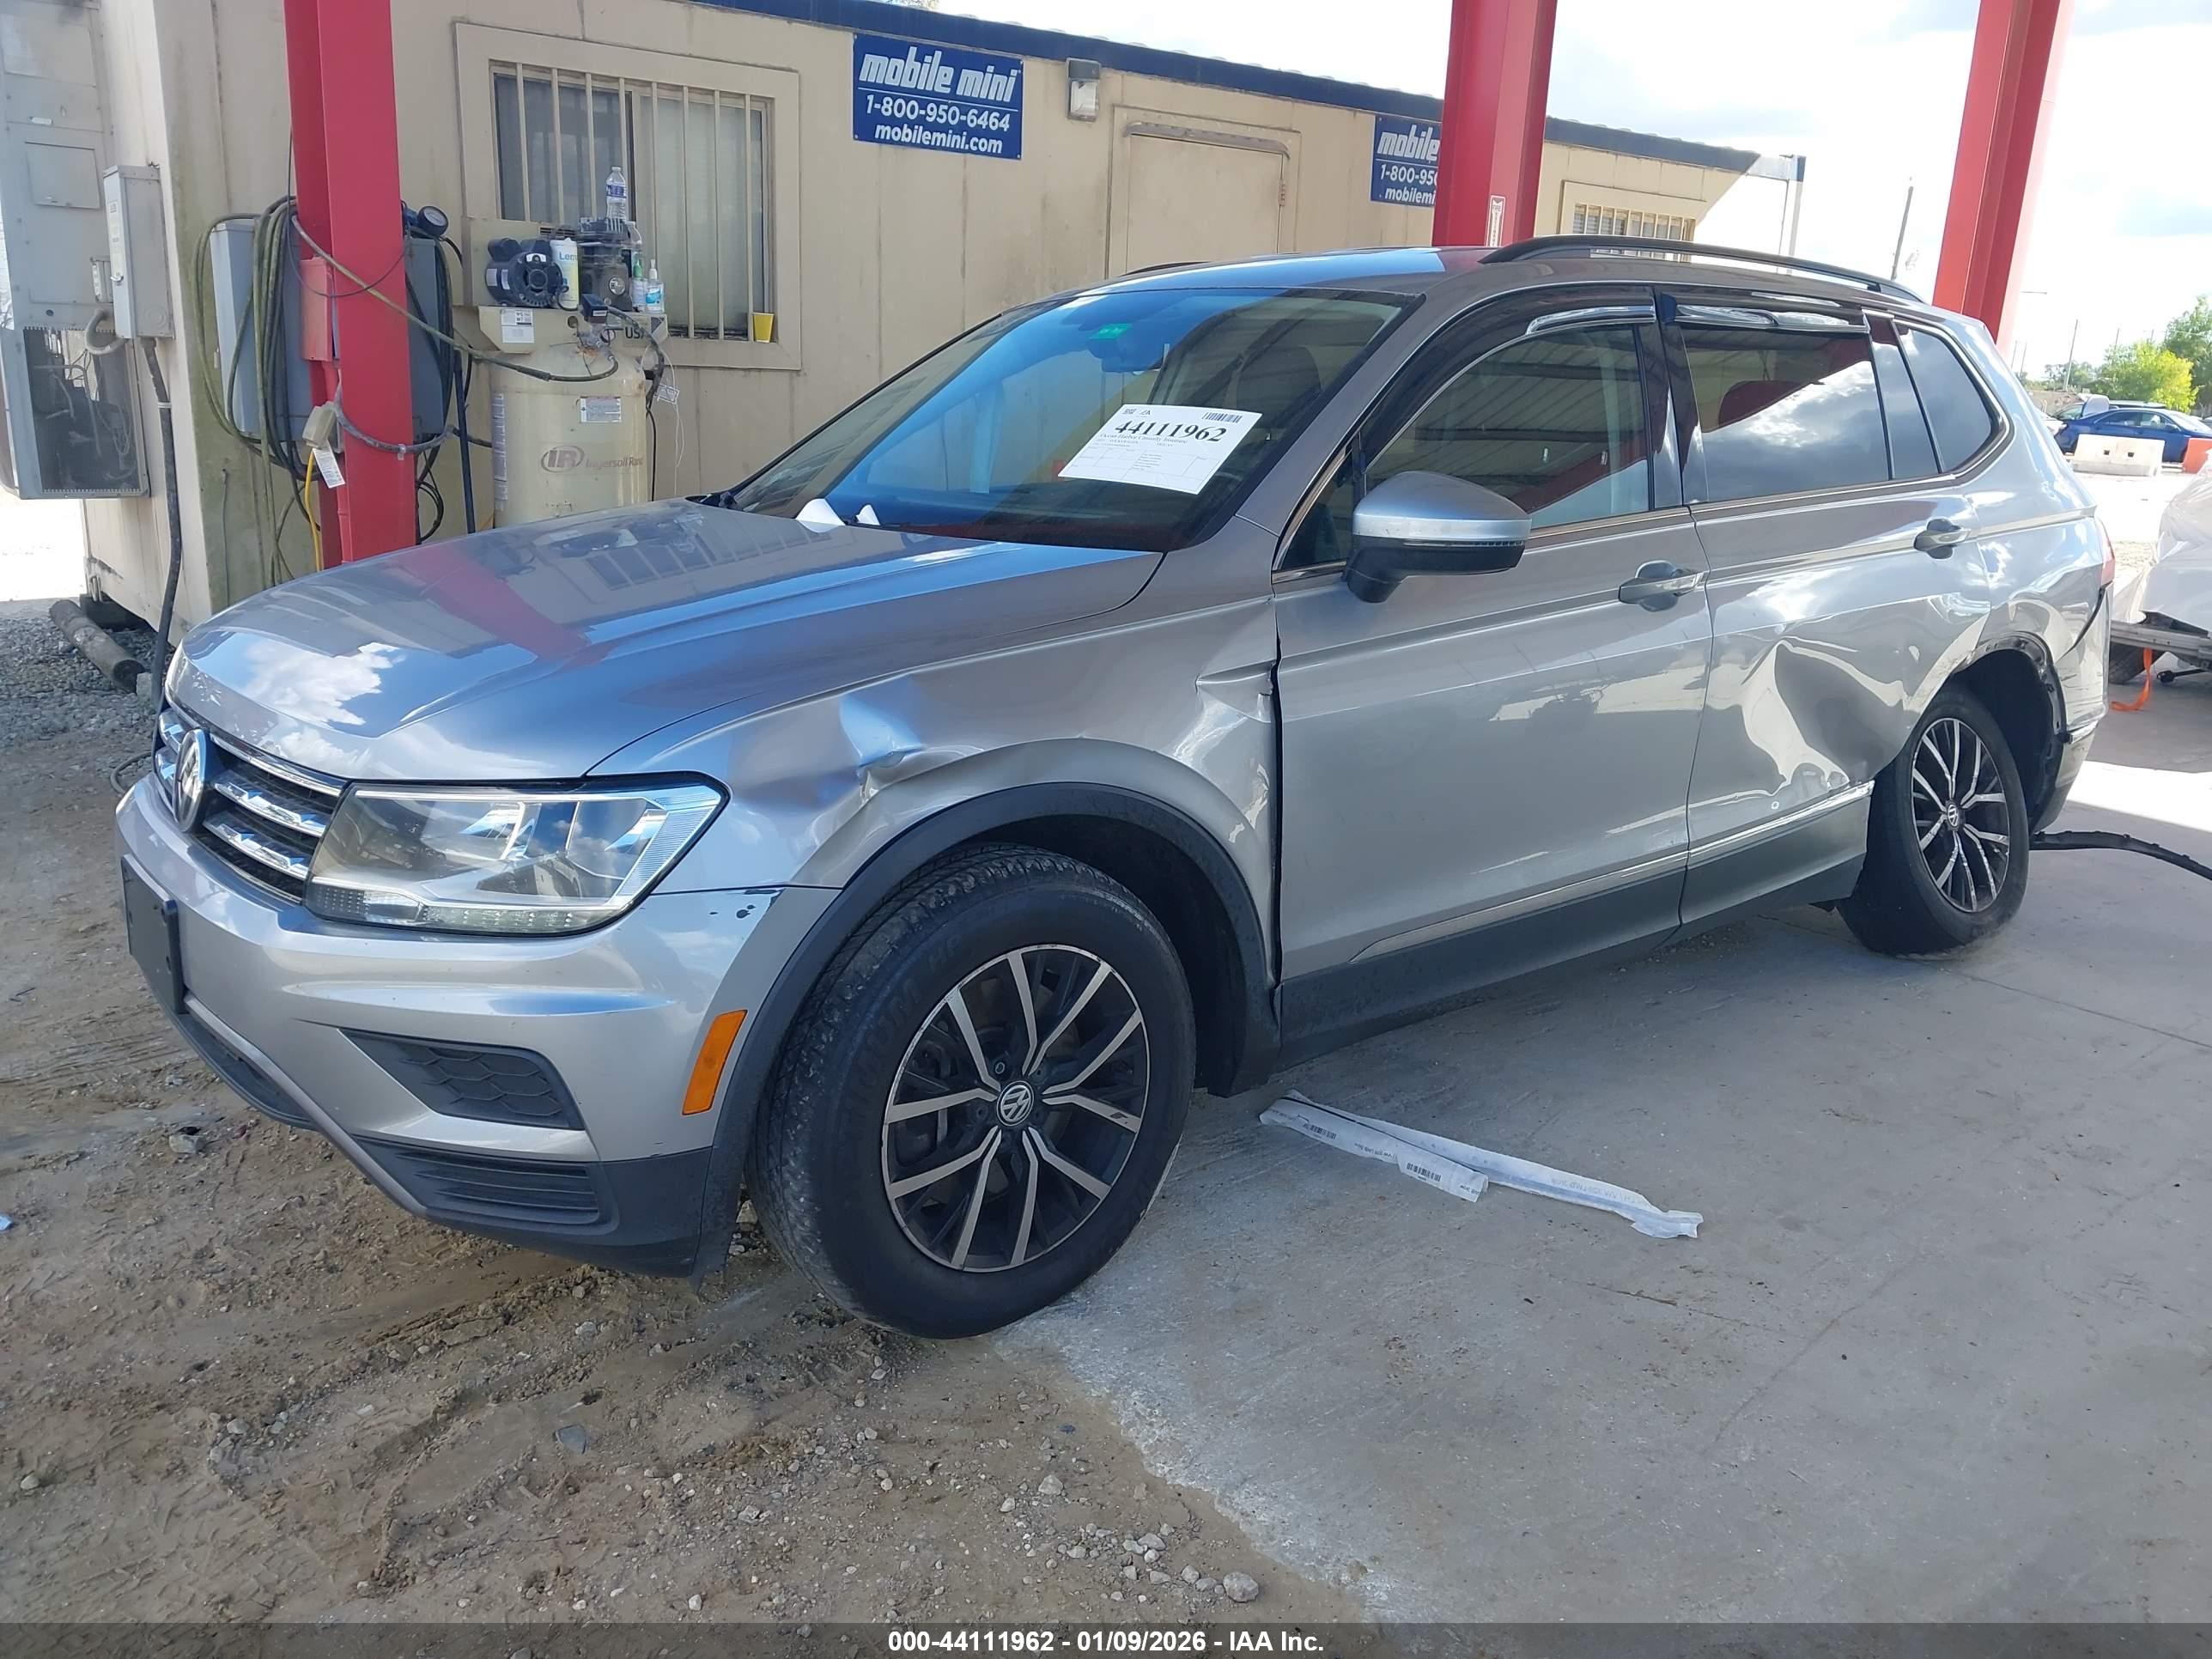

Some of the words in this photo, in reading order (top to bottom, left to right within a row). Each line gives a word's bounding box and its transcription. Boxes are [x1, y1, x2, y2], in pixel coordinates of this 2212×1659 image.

[859, 46, 955, 94] mobile
[956, 65, 1018, 103] mini
[866, 94, 1011, 132] 1-800-950-6464
[874, 123, 1003, 154] mobilemini.com
[1376, 124, 1441, 161] mobile
[1115, 420, 1228, 442] 44111962
